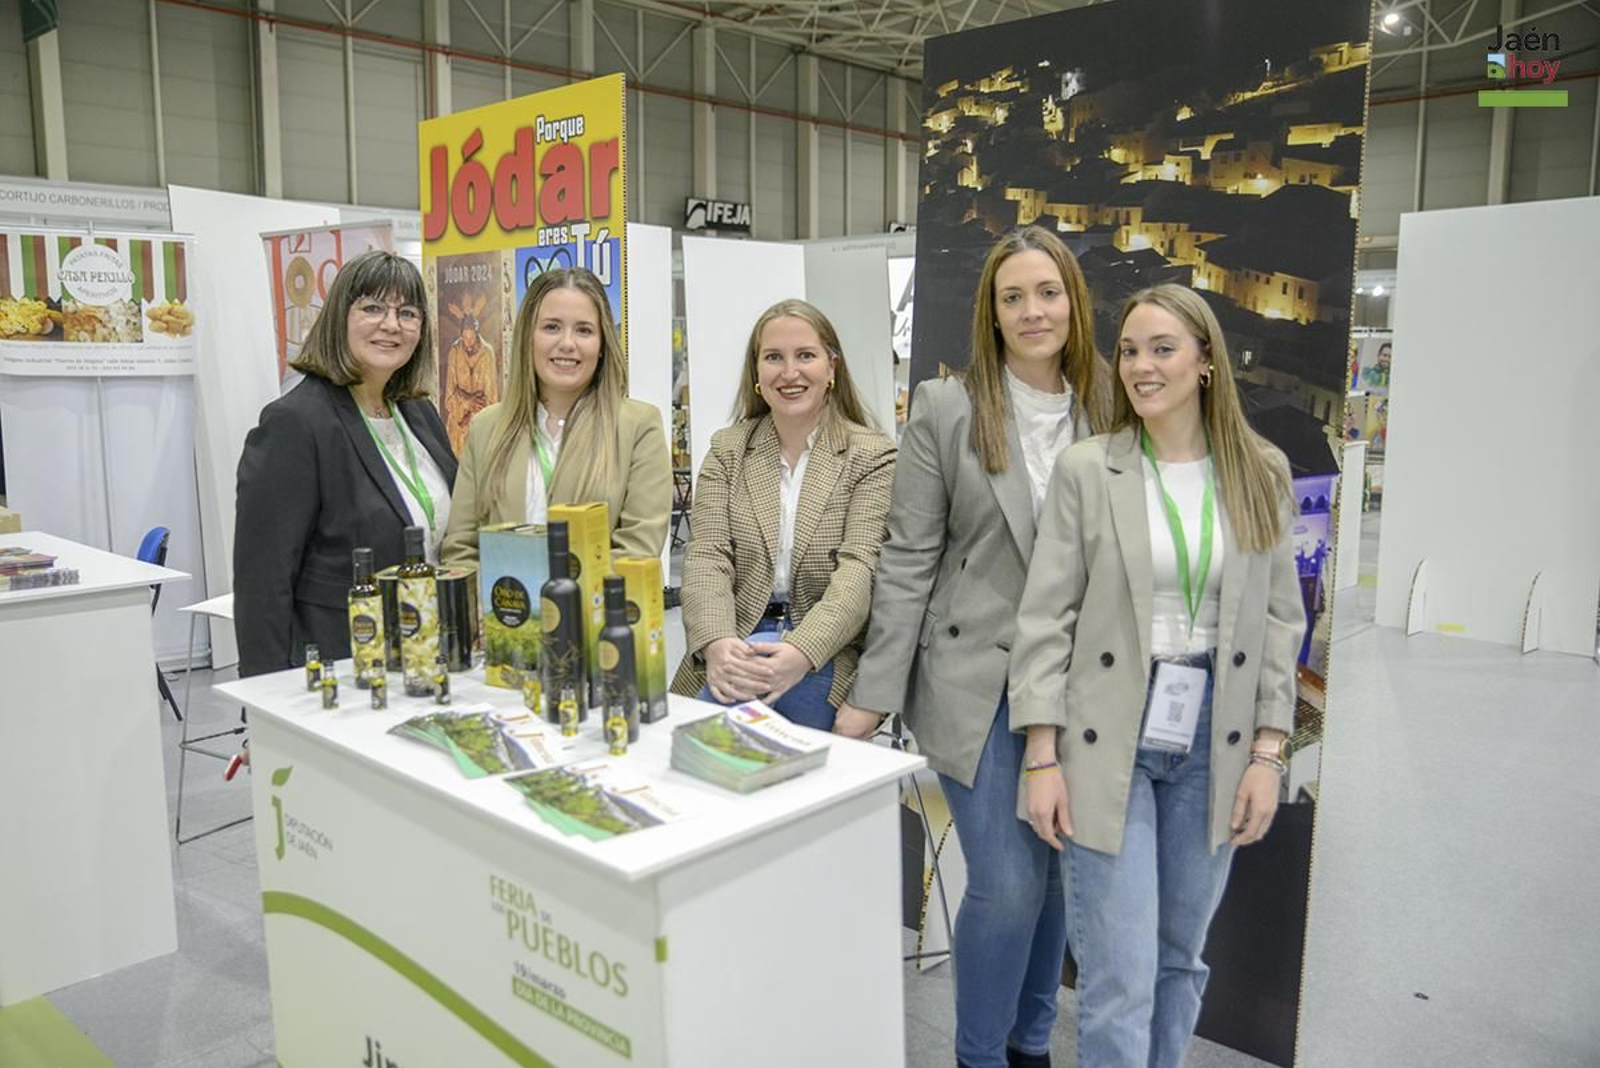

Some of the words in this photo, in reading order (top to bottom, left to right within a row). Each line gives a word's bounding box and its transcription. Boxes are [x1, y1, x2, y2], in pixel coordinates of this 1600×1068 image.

[535, 114, 586, 145] Porque
[0, 189, 47, 204] CORTIJO
[423, 127, 620, 242] Jódar
[705, 199, 750, 226] IFEJA
[537, 225, 569, 248] eres
[570, 222, 613, 287] Tú
[56, 268, 88, 282] CASA
[471, 262, 493, 283] 2024
[489, 873, 538, 918] FERIA
[506, 908, 629, 998] PUEBLOS
